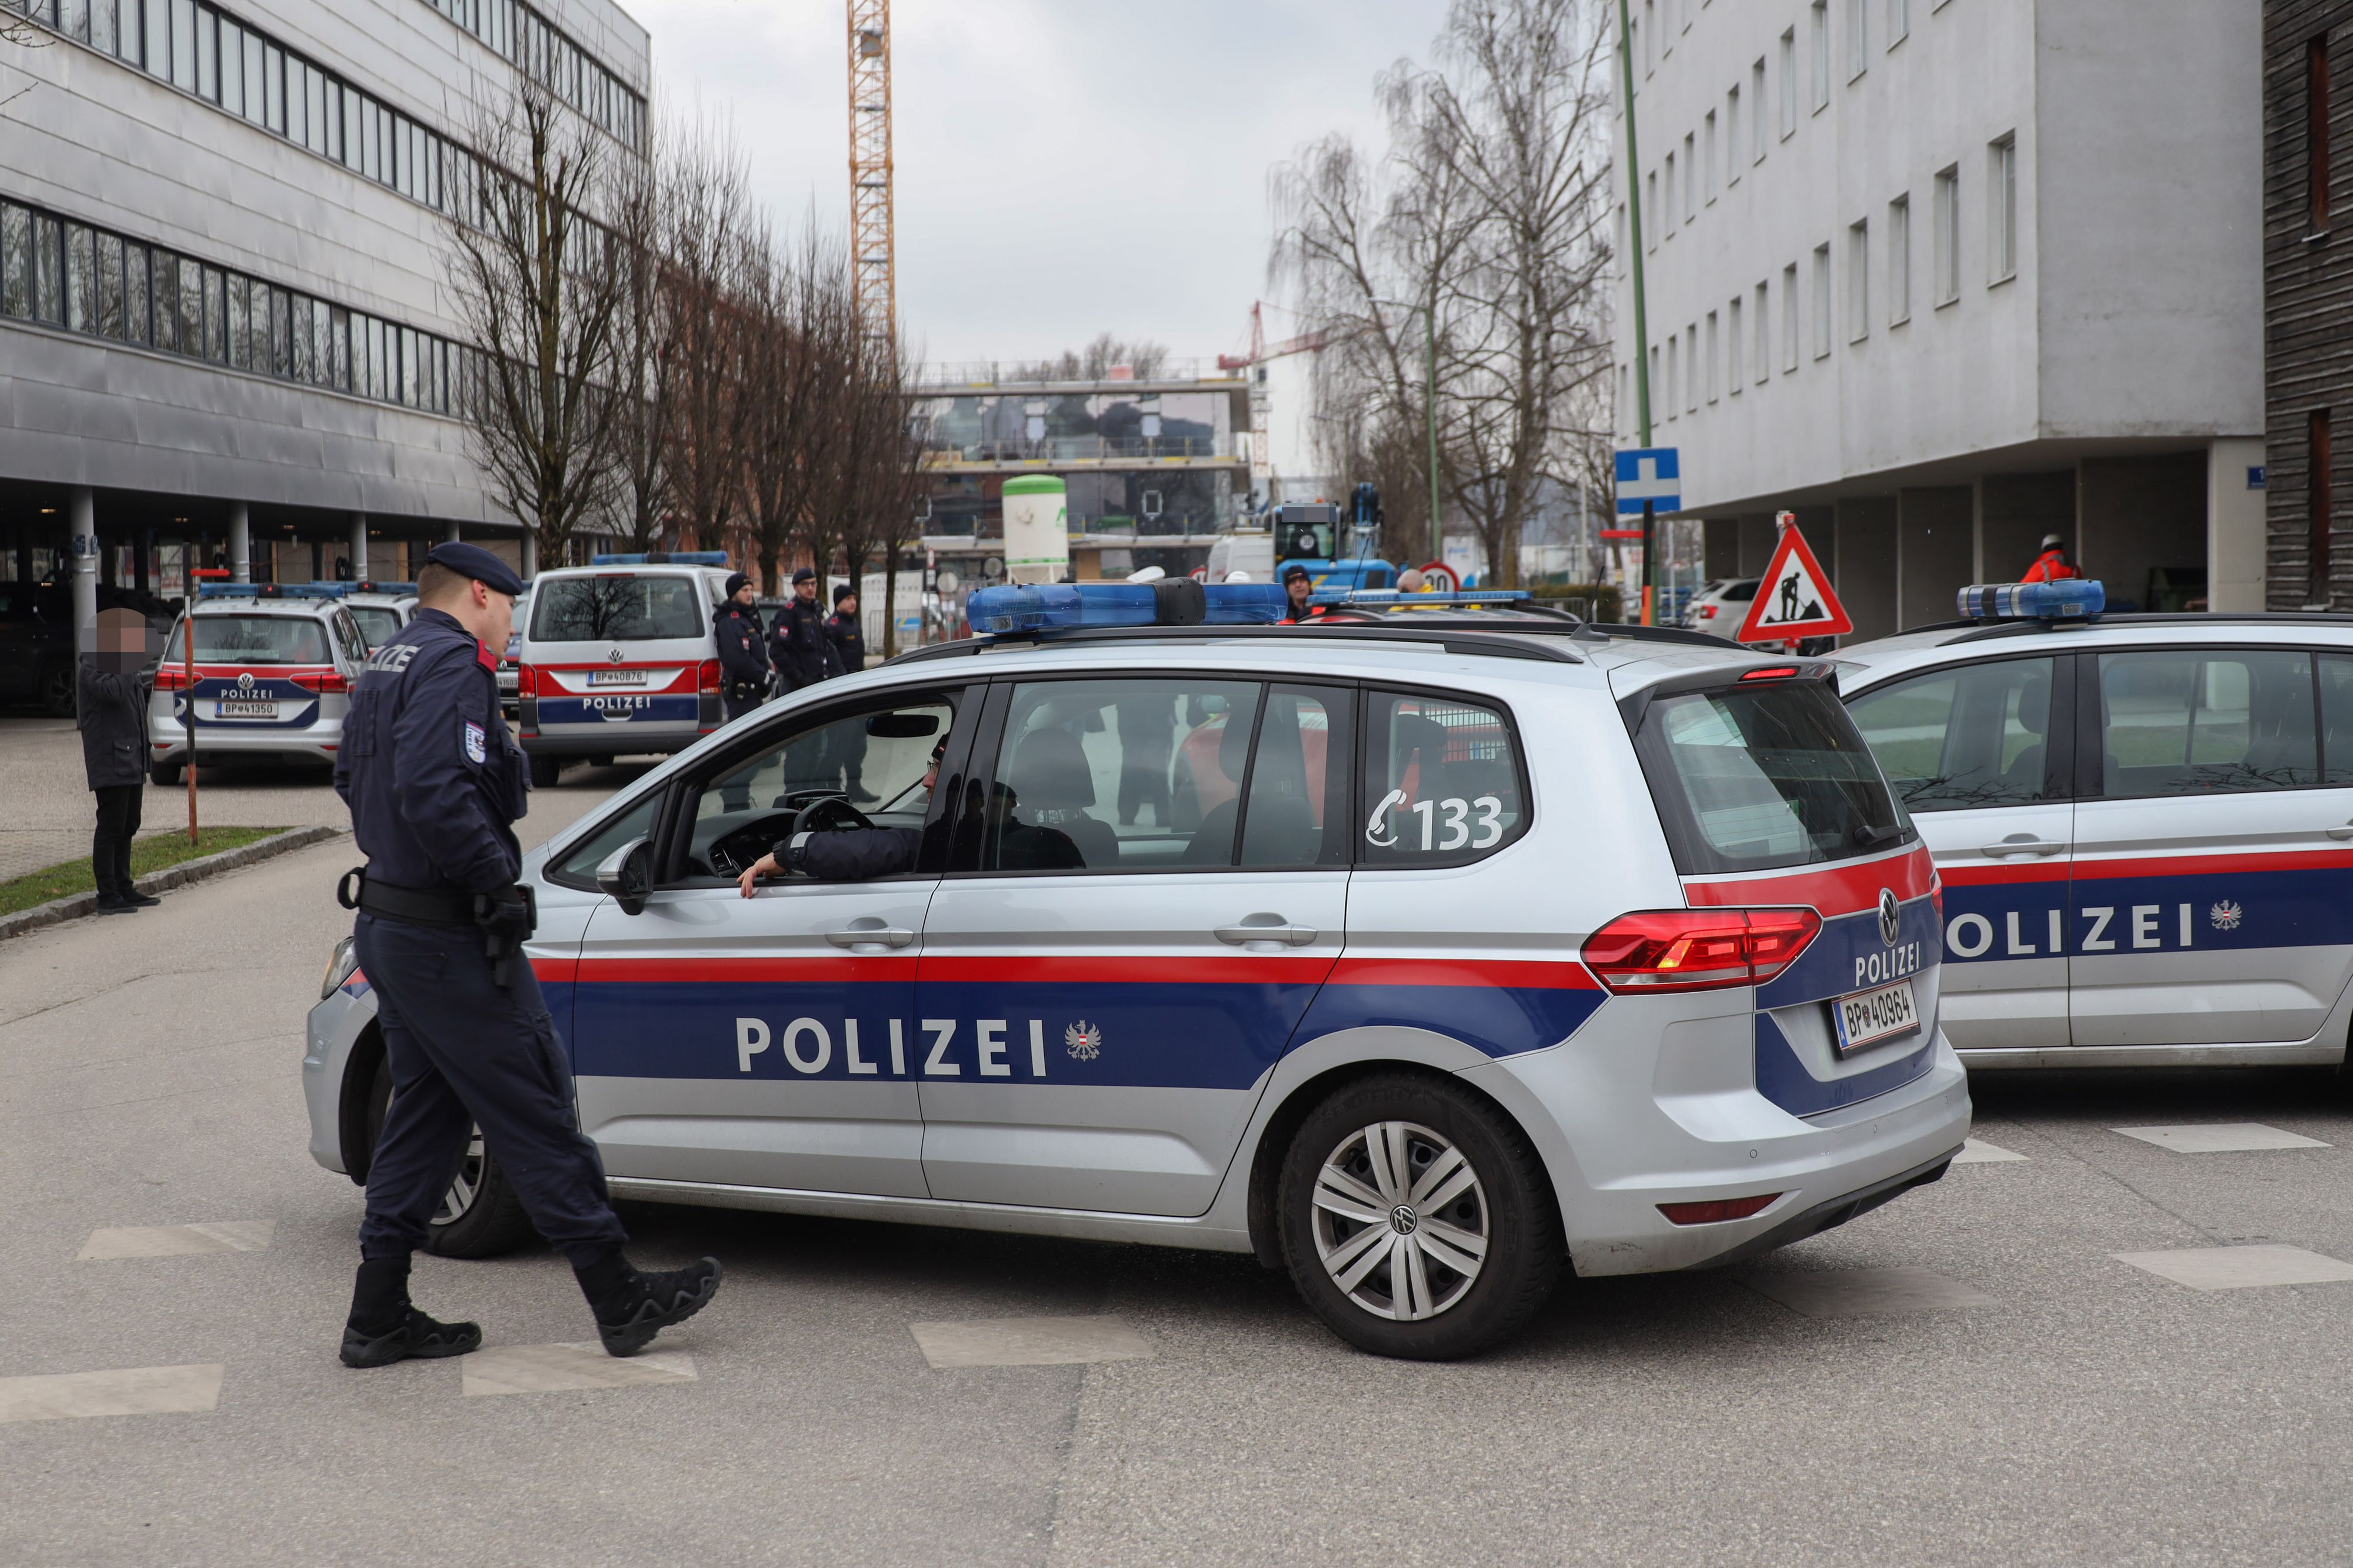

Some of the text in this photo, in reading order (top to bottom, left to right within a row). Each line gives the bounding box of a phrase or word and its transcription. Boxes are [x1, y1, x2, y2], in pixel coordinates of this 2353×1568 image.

[221, 689, 272, 699] POLIZEI
[596, 672, 642, 681] BP 40876
[225, 703, 272, 713] BP 41350
[583, 696, 651, 710] POLIZEI
[1412, 796, 1502, 850] 133
[1946, 903, 2192, 958] OLIZEI
[1855, 941, 1919, 987] POLIZEI
[1846, 988, 1911, 1037] BP 40964
[736, 1017, 1046, 1077] POLIZEI
